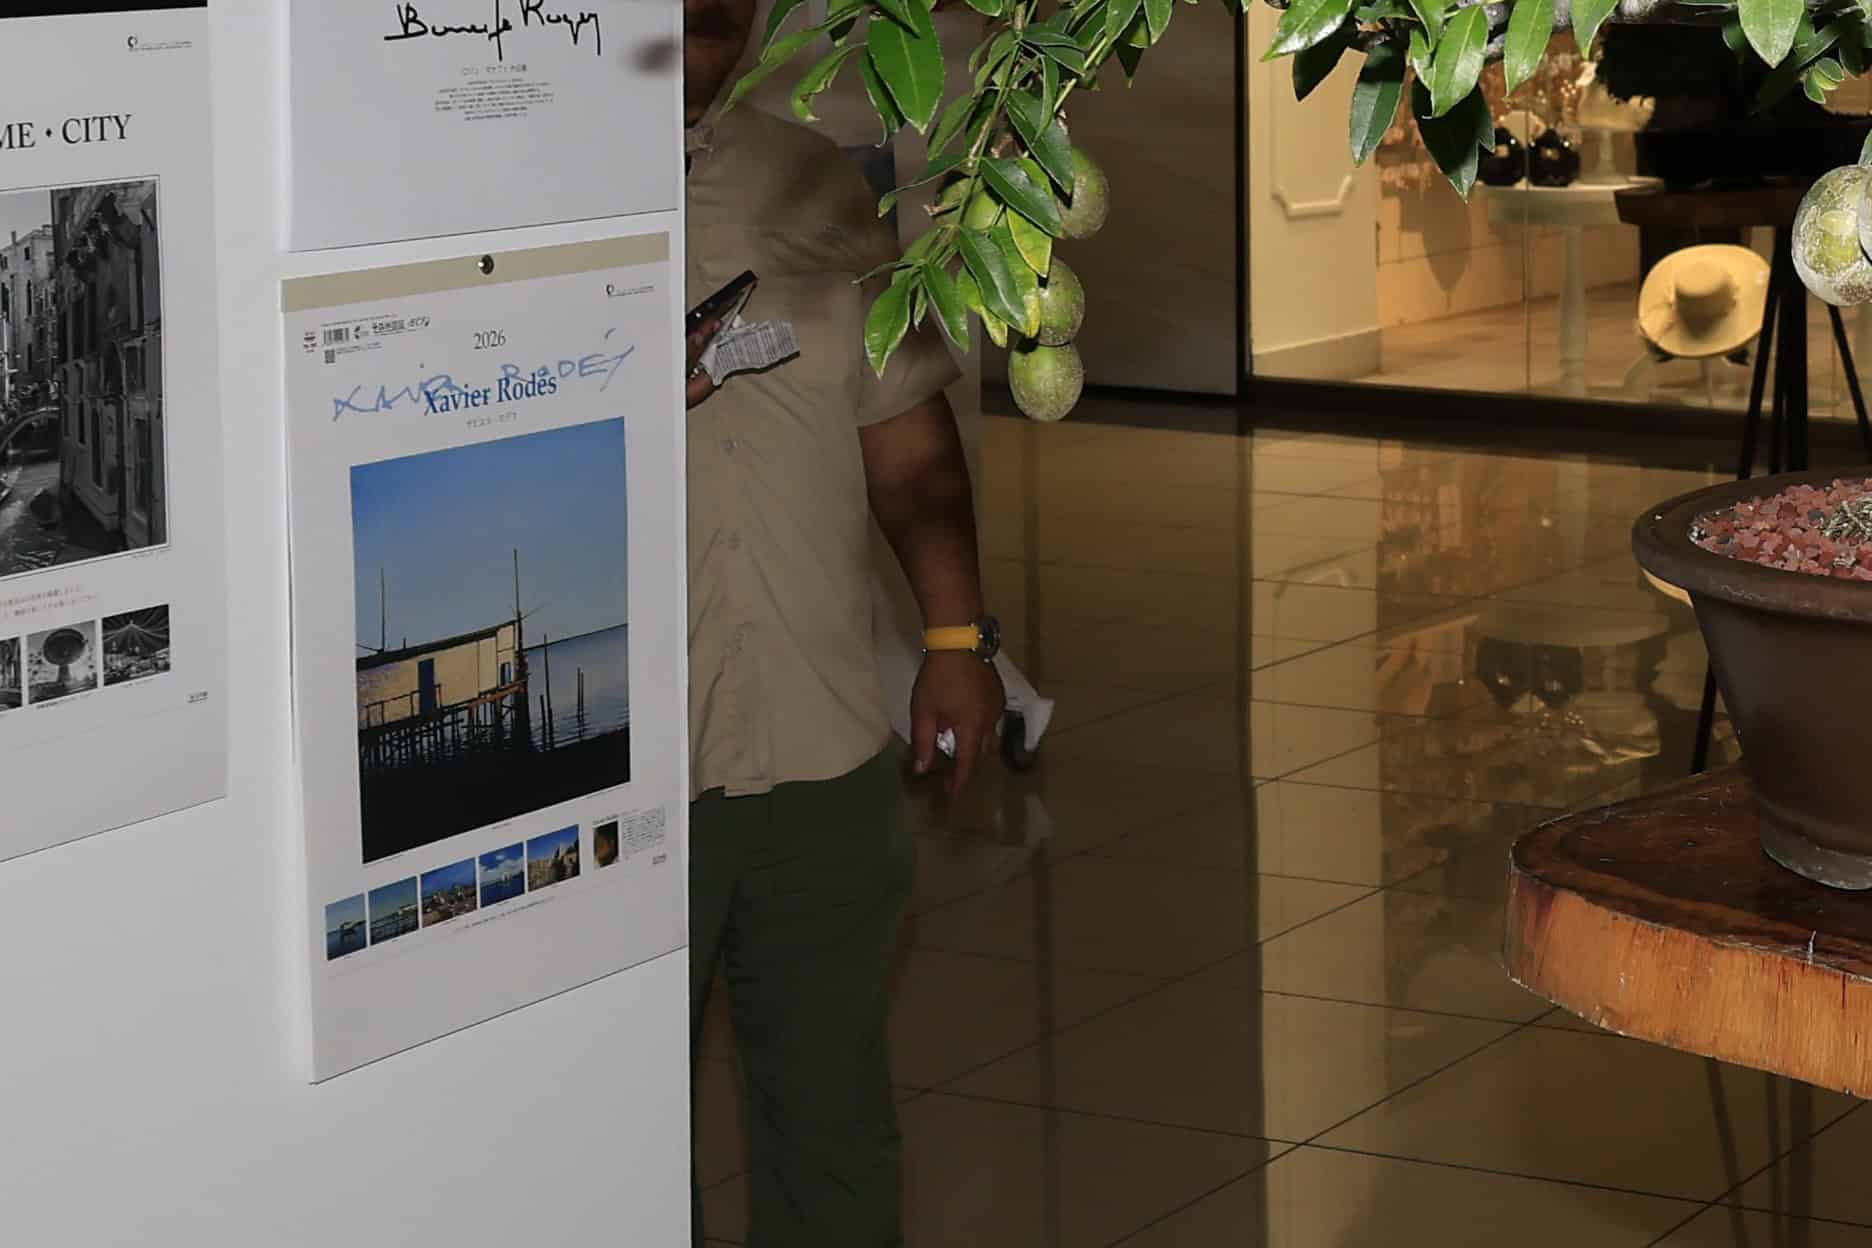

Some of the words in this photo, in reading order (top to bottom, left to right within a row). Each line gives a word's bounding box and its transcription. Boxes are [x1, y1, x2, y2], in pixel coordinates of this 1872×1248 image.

[61, 114, 132, 144] CITY
[473, 329, 506, 350] 2026
[423, 383, 491, 415] Xavier
